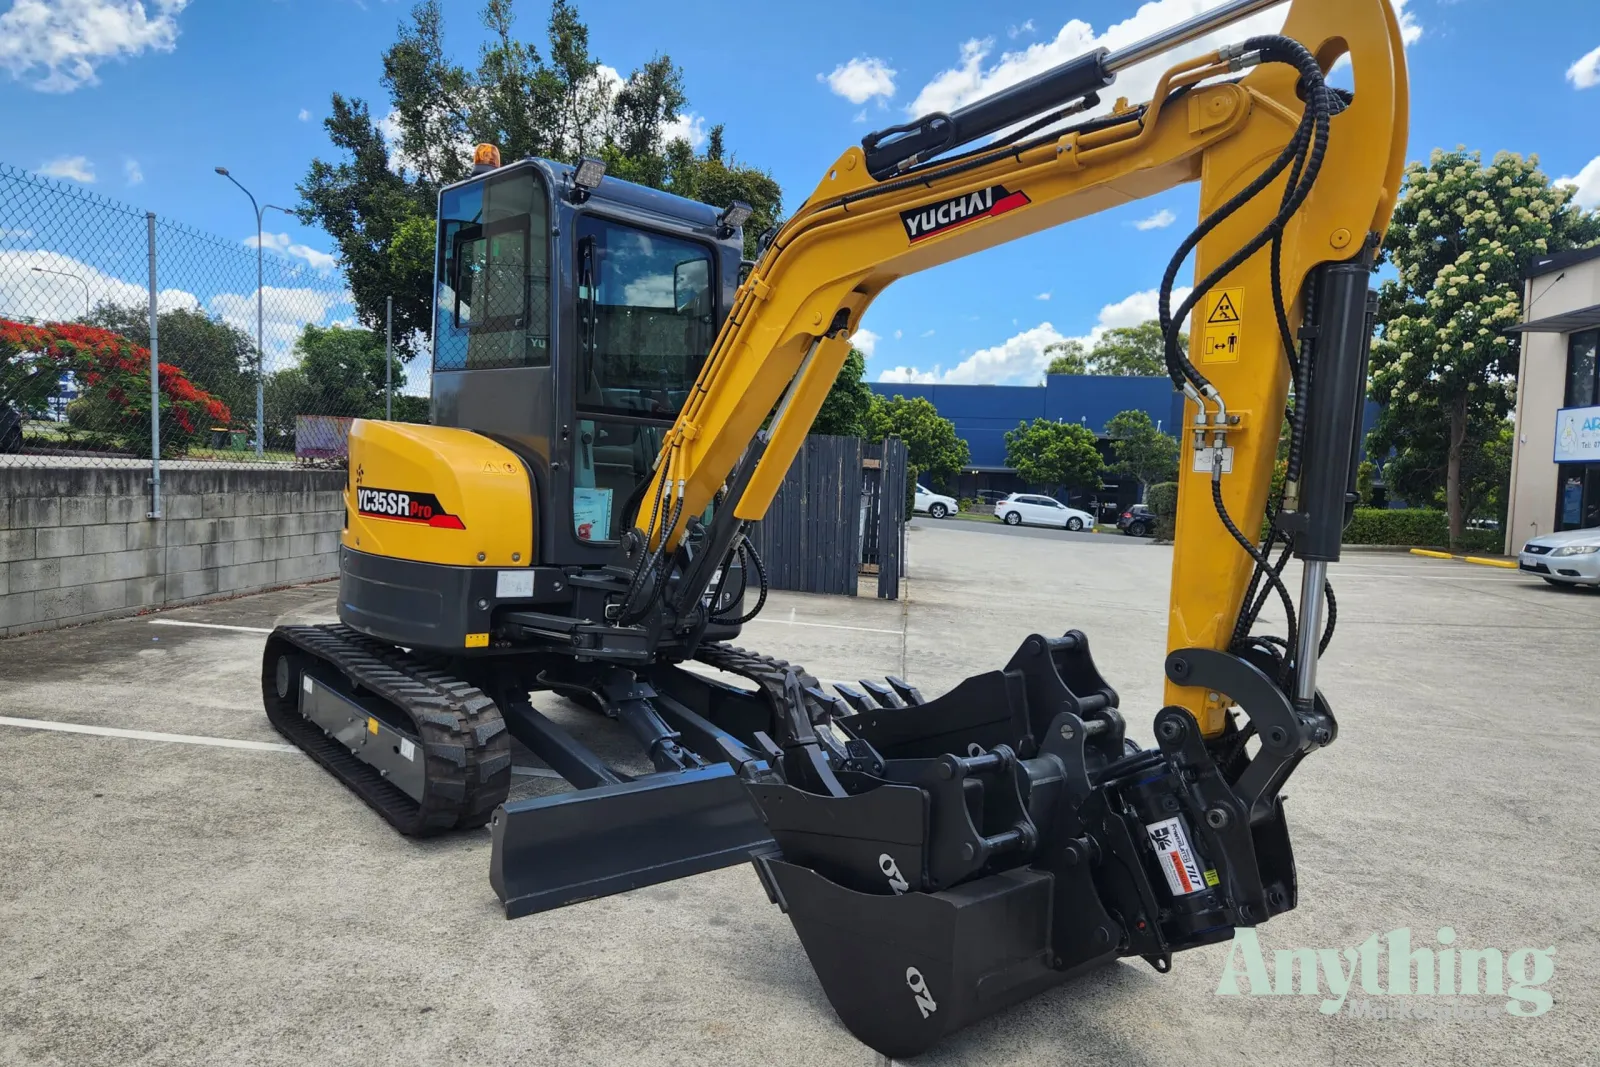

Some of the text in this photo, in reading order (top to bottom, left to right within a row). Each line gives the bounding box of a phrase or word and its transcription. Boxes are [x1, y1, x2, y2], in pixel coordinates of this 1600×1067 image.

[906, 187, 993, 236] YUCHAI
[1185, 863, 1201, 886] TILT
[906, 966, 937, 1019] OZ
